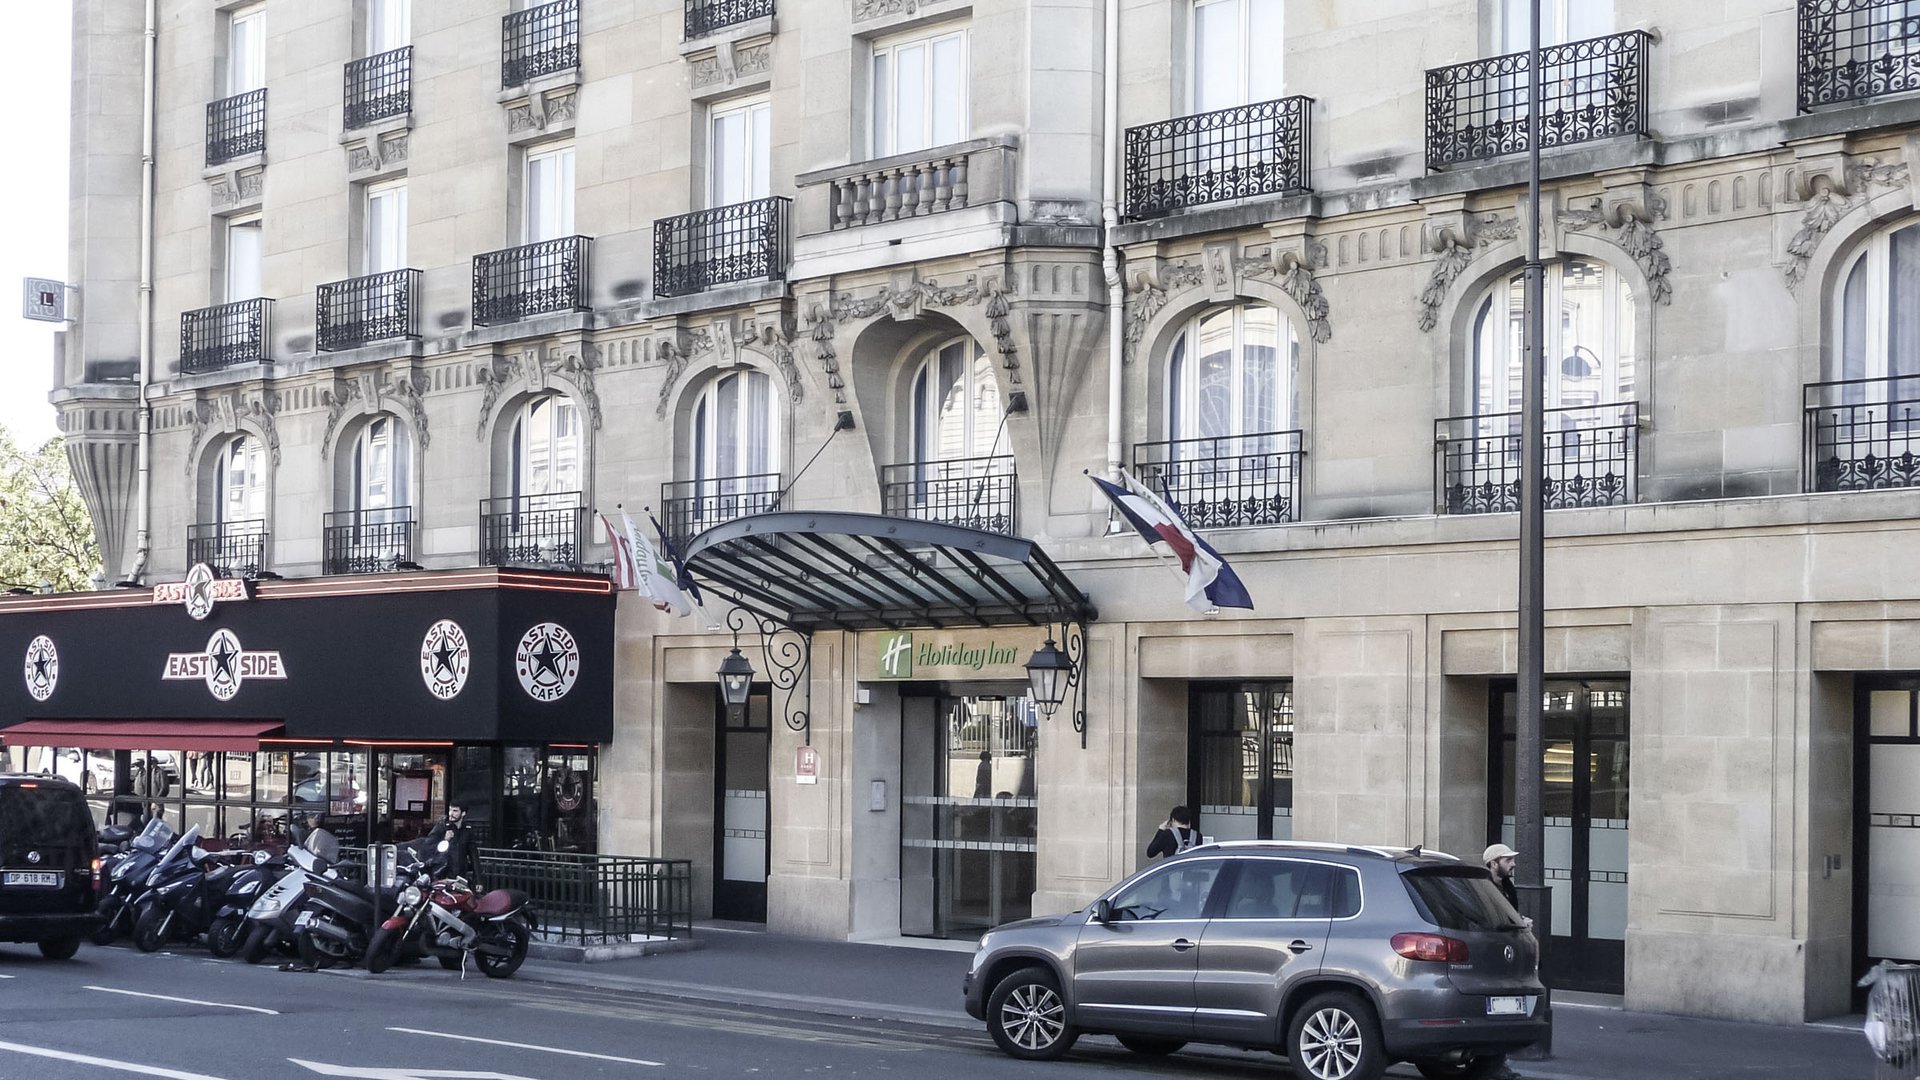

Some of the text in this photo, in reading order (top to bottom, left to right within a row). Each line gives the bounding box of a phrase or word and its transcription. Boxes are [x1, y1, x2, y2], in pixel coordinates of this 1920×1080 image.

[156, 581, 242, 601] EAST SIDE
[423, 623, 468, 661] EAST SIDE
[518, 625, 578, 663] EAST SIDE
[26, 638, 57, 669] EAST SIDE
[917, 641, 1018, 671] Holiday Inn
[169, 655, 278, 676] EAST SIDE
[432, 681, 458, 698] CAFE
[530, 684, 564, 700] CAFE
[805, 752, 814, 764] H
